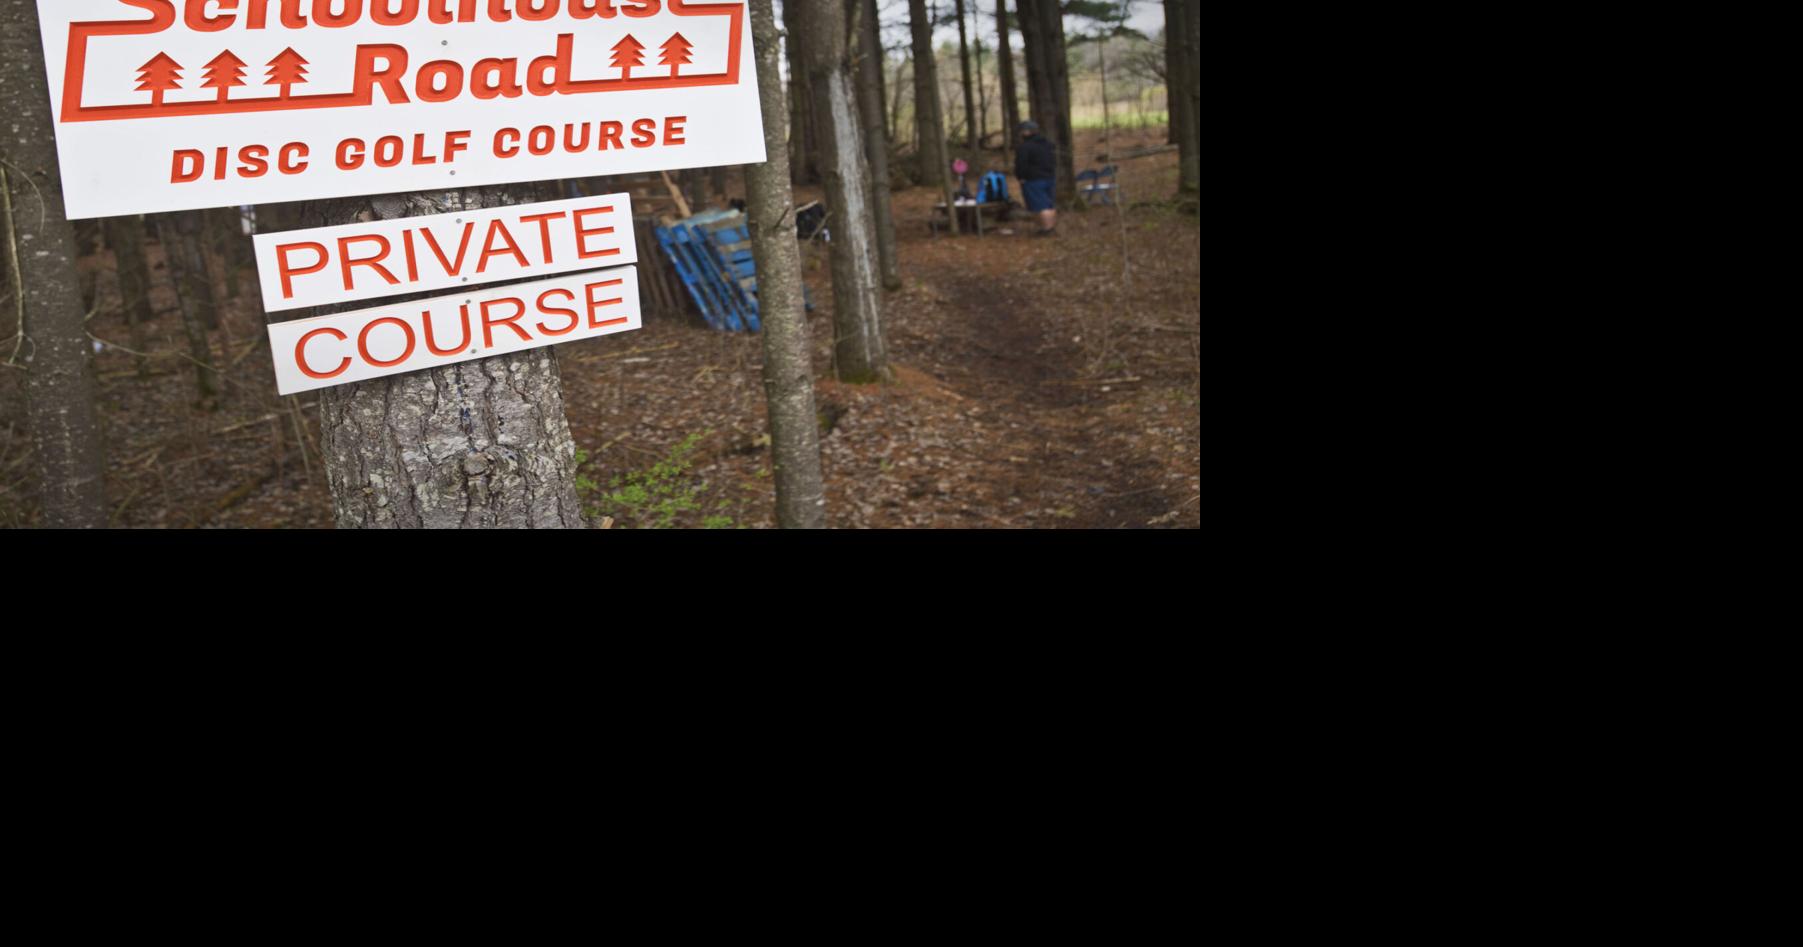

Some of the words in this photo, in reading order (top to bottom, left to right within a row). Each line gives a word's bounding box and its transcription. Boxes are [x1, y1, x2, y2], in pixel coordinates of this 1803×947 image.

[352, 33, 575, 106] Road
[170, 141, 310, 185] DISC
[335, 130, 472, 171] GOLF
[492, 115, 688, 159] COURSE
[275, 205, 621, 300] PRIVATE
[294, 278, 629, 380] COURSE
